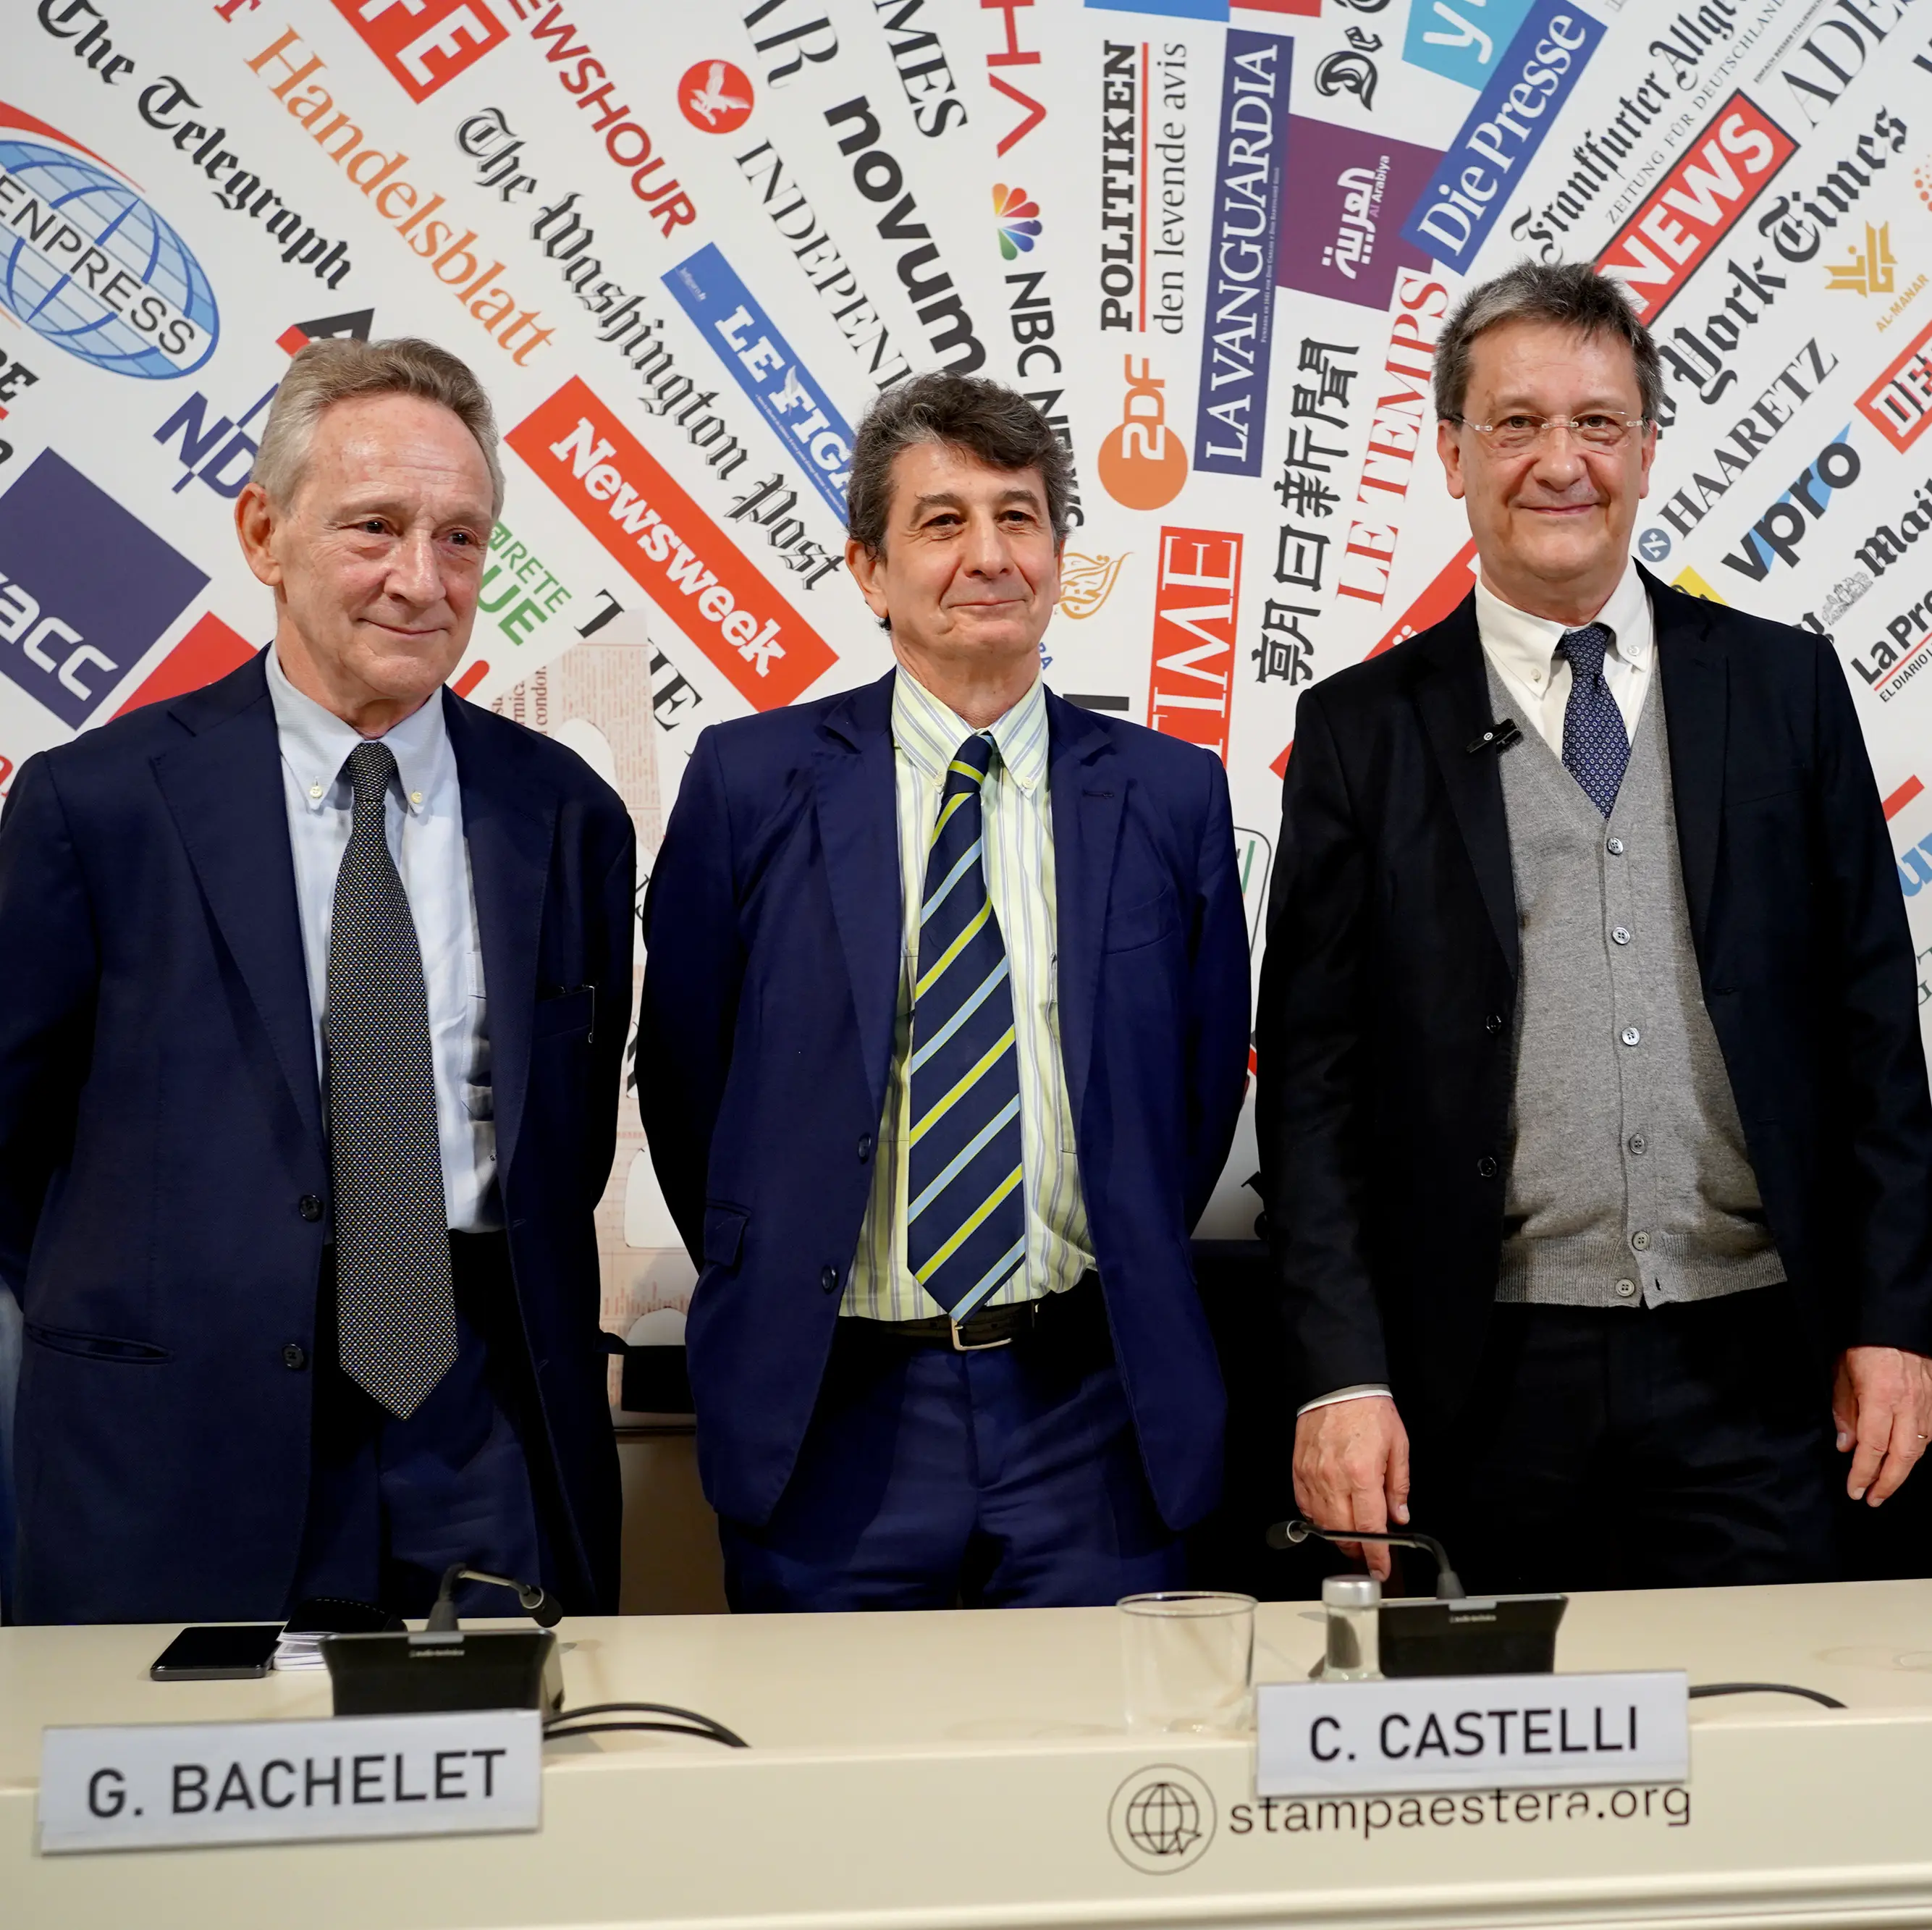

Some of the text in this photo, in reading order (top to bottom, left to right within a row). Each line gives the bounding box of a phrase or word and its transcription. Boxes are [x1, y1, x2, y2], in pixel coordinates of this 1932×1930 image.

[38, 0, 352, 290] The Telegraph
[243, 24, 557, 367] Handelsblatt
[1100, 40, 1136, 334] POLITIKEN
[1153, 42, 1187, 334] den levende avis
[1371, 155, 1391, 203] Arabiya
[1417, 14, 1587, 257] Die Presse
[1510, 70, 1672, 266] Frankfurter
[1598, 112, 1774, 315] NEWS
[1605, 150, 1666, 225] ZEITUNG
[1664, 113, 1695, 148] FÜR
[824, 95, 987, 378] novum
[1005, 271, 1063, 379] NBC
[1658, 255, 1787, 405] York
[1758, 105, 1909, 264] Times
[1875, 273, 1929, 333] AL-MANAR
[455, 107, 539, 203] The
[531, 193, 749, 481] Washington
[724, 472, 845, 591] Post
[714, 304, 786, 383] LE
[1121, 353, 1165, 460] ZDF
[1656, 337, 1840, 541] HAARETZ
[1251, 337, 1360, 686] 朝日新聞
[1335, 276, 1450, 611] LE TEMPS
[1721, 442, 1861, 583] vpro
[549, 418, 787, 678] Newsweek
[1850, 640, 1899, 686] La
[1878, 653, 1928, 703] EL DIARIO
[87, 1748, 506, 1819] G. BACHELET
[1229, 1785, 1690, 1840] stampaestera.org
[1309, 1705, 1638, 1762] C. CASTELLI
